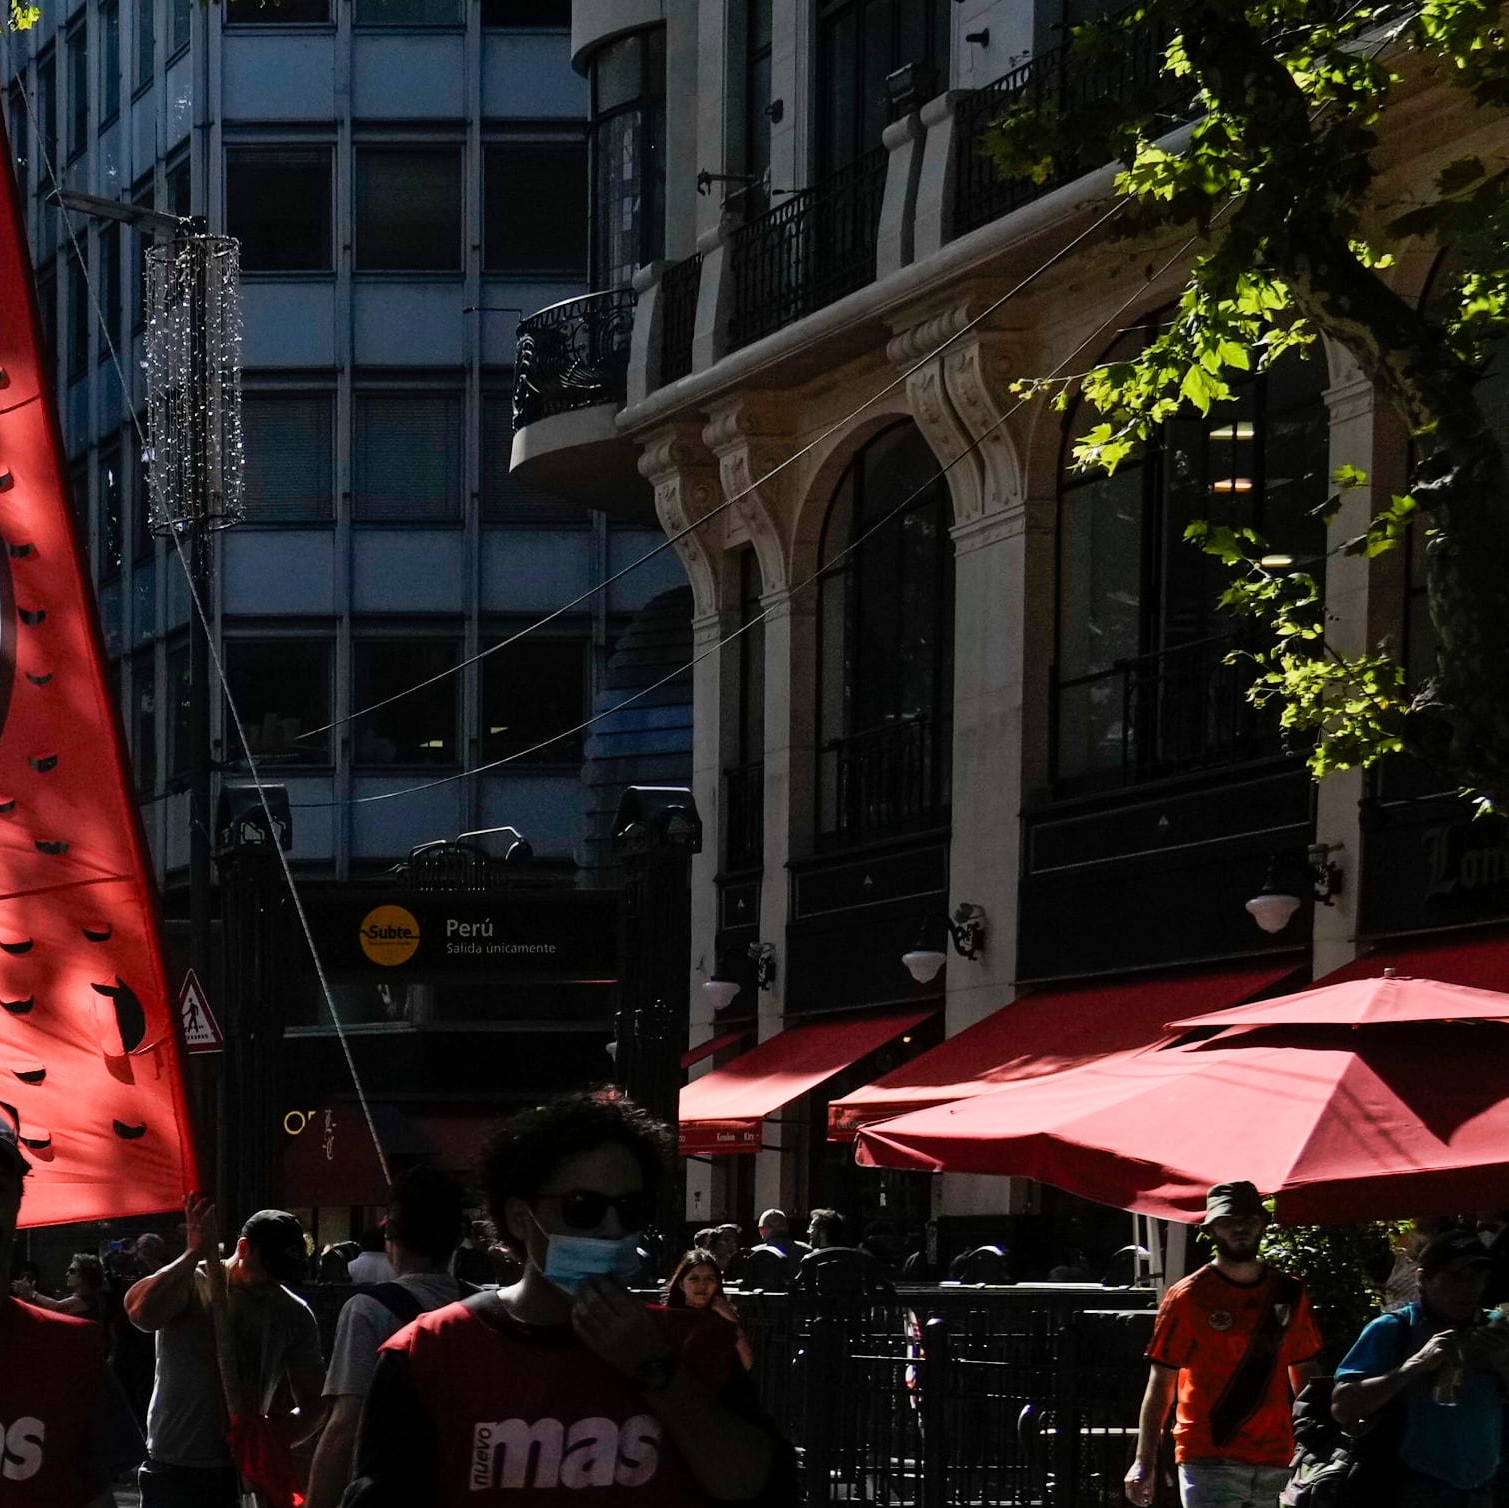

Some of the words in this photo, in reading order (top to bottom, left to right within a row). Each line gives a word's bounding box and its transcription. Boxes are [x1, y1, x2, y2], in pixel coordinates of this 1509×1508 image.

[1421, 825, 1509, 902] Lon
[369, 925, 411, 939] Subte
[446, 917, 494, 937] Perú
[446, 942, 483, 955] Salida
[486, 942, 557, 954] únicamente
[469, 1414, 663, 1491] mas
[474, 1427, 492, 1486] nuevo
